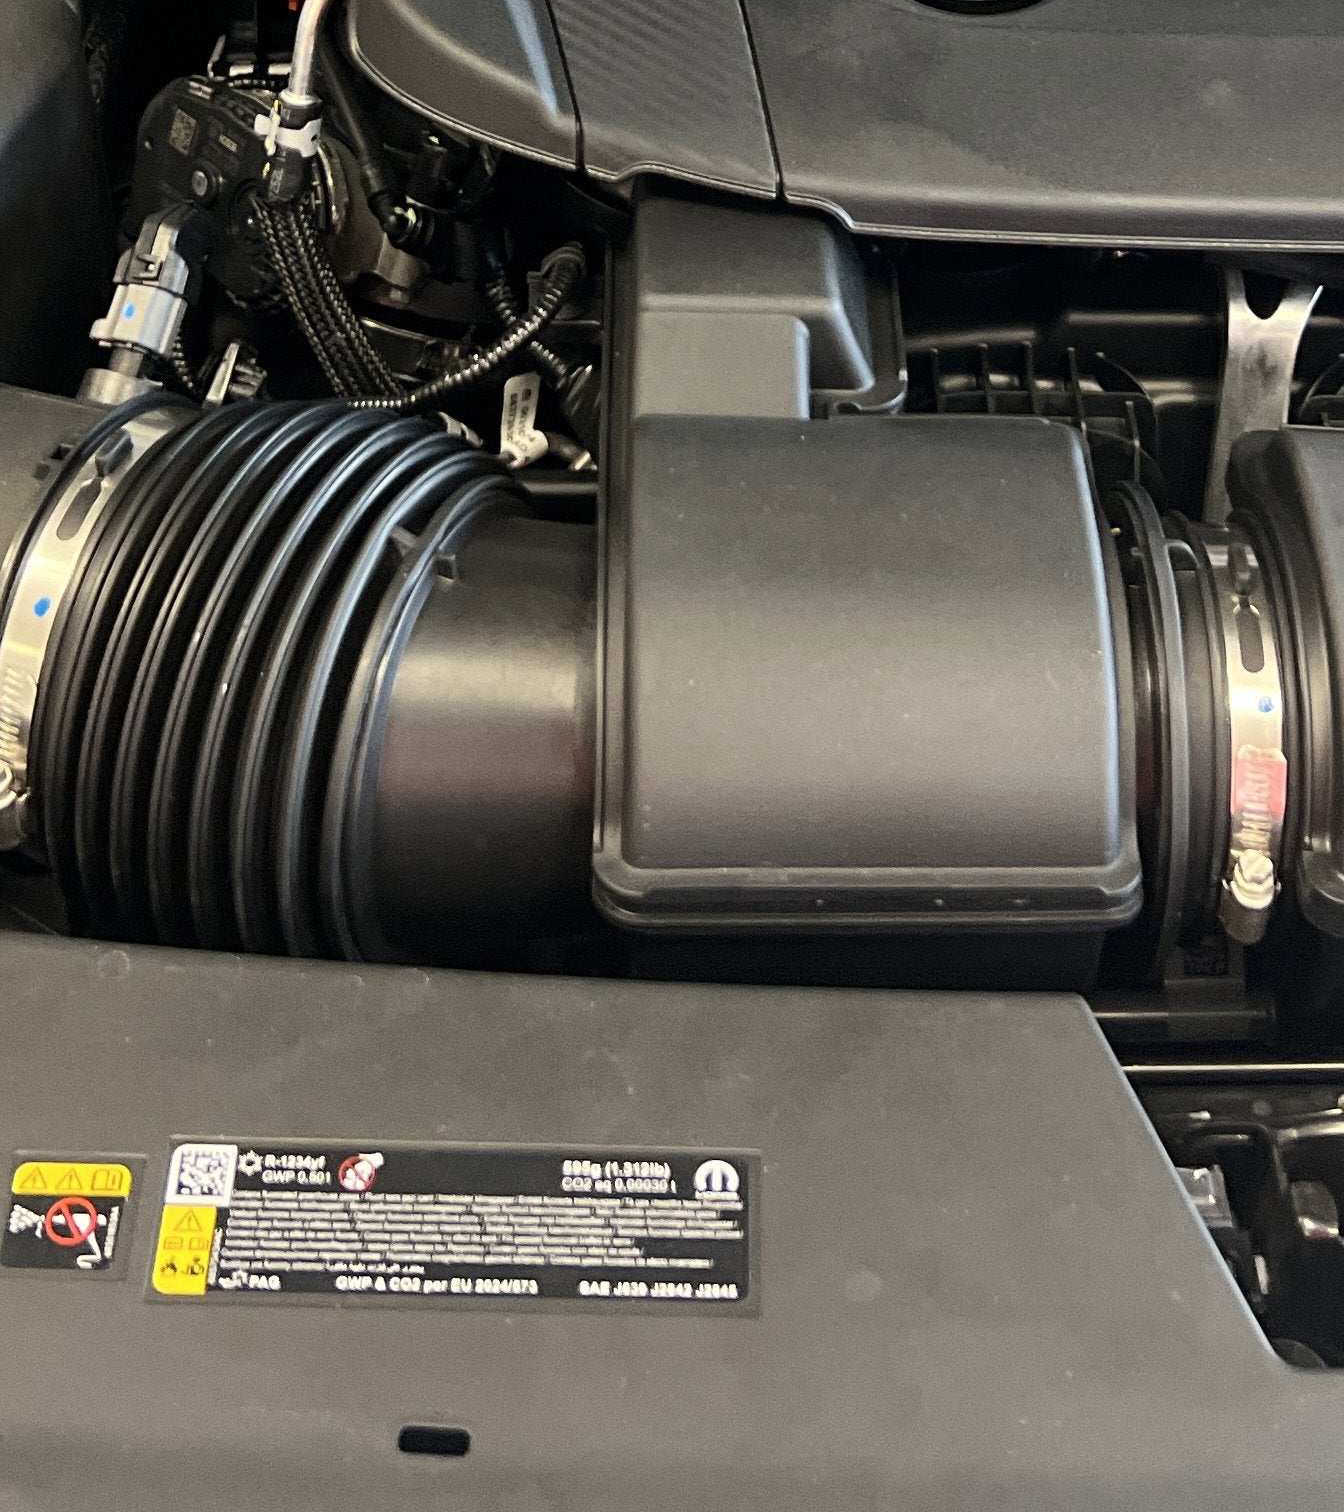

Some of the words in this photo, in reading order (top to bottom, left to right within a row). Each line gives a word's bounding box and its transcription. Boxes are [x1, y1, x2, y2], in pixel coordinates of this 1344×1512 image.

[264, 1153, 326, 1171] R-1234yf
[262, 1170, 295, 1185] GWP
[561, 1176, 593, 1192] CO2
[248, 1274, 282, 1290] PAG
[335, 1275, 373, 1290] GWP
[388, 1276, 421, 1292] CO2
[450, 1277, 473, 1293] EU
[578, 1280, 611, 1296] SAE
